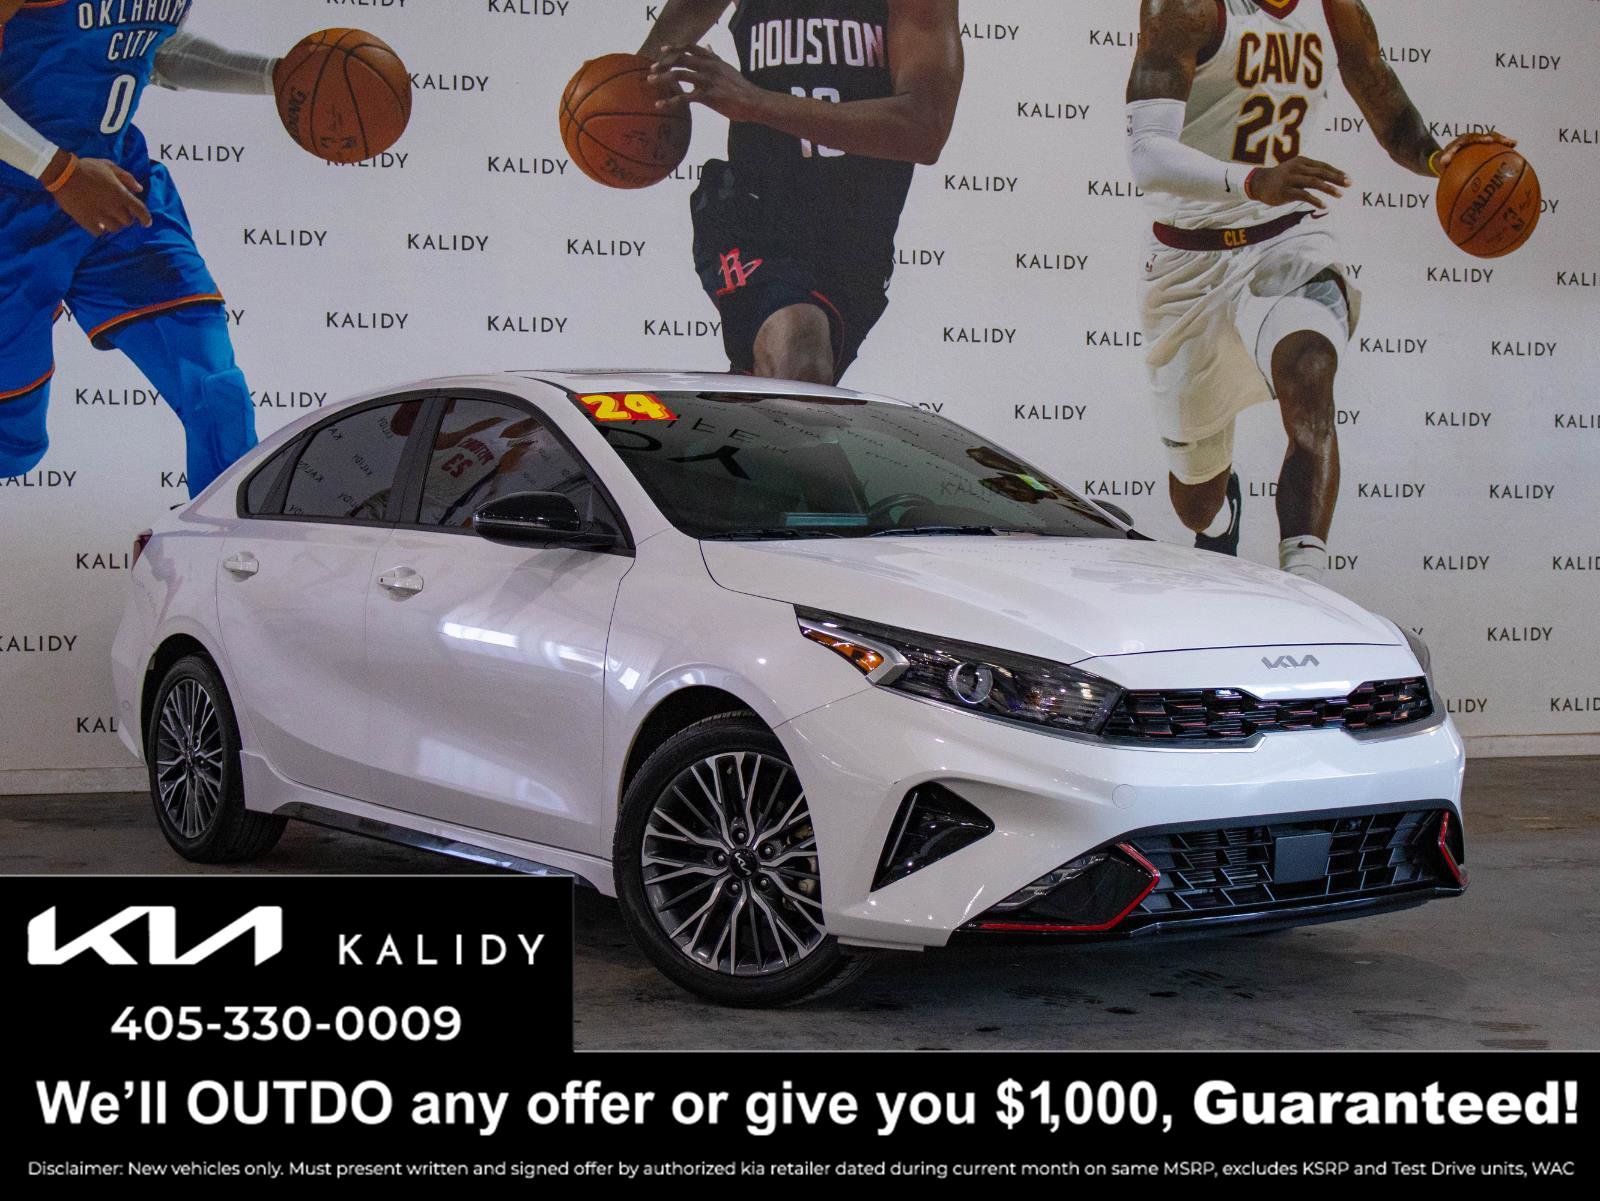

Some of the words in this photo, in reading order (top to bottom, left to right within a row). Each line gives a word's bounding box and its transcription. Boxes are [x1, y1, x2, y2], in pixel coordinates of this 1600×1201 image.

[489, 0, 568, 16] KALIDY
[108, 29, 157, 61] CITY
[750, 18, 884, 72] HOUSTON
[1090, 30, 1141, 46] KALI
[1235, 31, 1323, 90] CAVS
[1496, 53, 1560, 70] KALIDY
[409, 73, 488, 91] KALIDY
[100, 74, 136, 134] 0
[1018, 102, 1089, 119] KALIDY
[1231, 93, 1309, 167] 23
[160, 144, 244, 162] KALIDY
[488, 156, 568, 174] KALIDY
[945, 175, 1017, 192] KALIDY
[1363, 192, 1429, 208] KALIDY
[245, 229, 327, 246] KALIDY
[408, 234, 488, 251] KALIDY
[1223, 229, 1248, 247] CLE
[568, 239, 645, 256] KALIDY
[893, 250, 945, 265] LIDY
[1017, 254, 1088, 270] KALIDY
[1428, 267, 1493, 283] KALIDY
[327, 312, 408, 329] KALIDY
[488, 316, 567, 332] KALIDY
[644, 320, 721, 336] KALIDY
[944, 327, 1016, 343] KALIDY
[1360, 338, 1427, 353] KALIDY
[1492, 341, 1556, 356] KALIDY
[76, 389, 160, 405] KALIDY
[581, 394, 668, 419] 24
[1015, 405, 1086, 420] KALIDY
[1426, 412, 1491, 426] KALIDY
[1555, 414, 1600, 429] KALI
[0, 471, 77, 487] ALIDY
[1085, 481, 1155, 495] KALIDY
[1359, 484, 1425, 497] KALIDY
[1490, 485, 1554, 499] KALIDY
[77, 553, 128, 569] KALI
[1424, 556, 1489, 570] KALIDY
[1488, 627, 1552, 641] KALIDY
[0, 635, 77, 651] ALIDY
[1261, 654, 1320, 671] KIA
